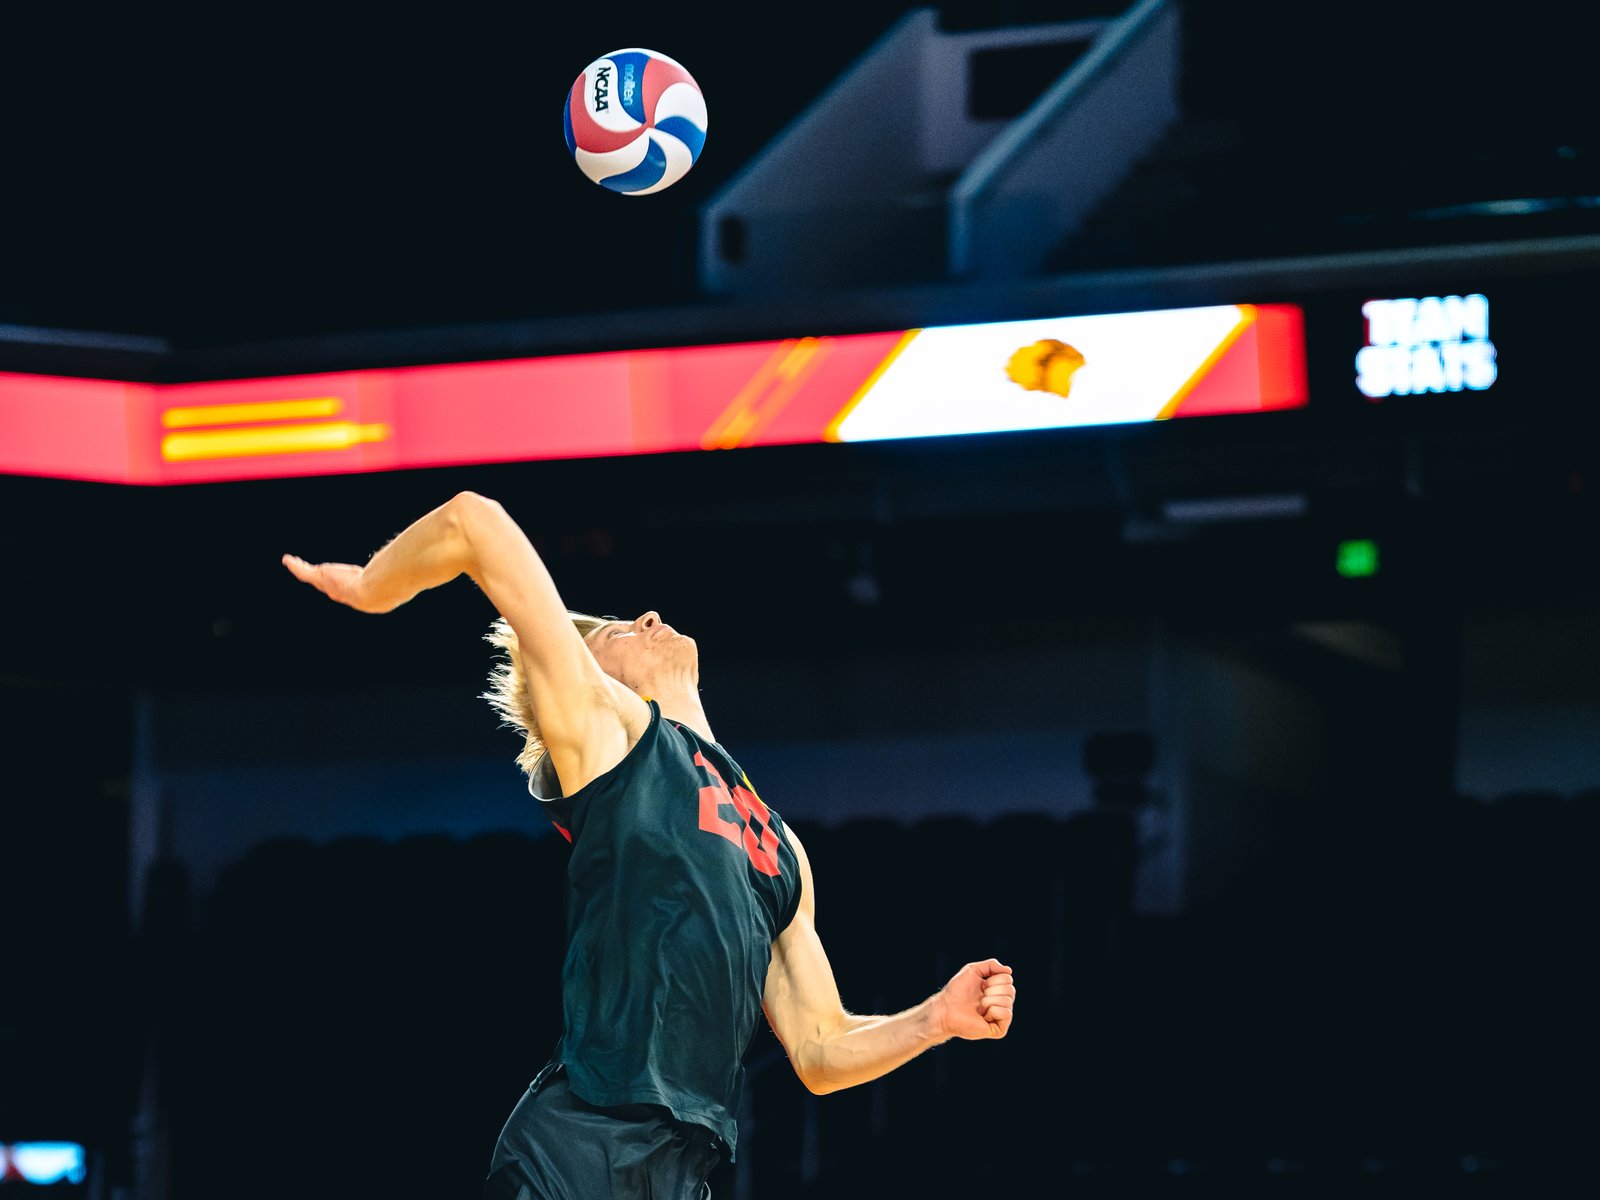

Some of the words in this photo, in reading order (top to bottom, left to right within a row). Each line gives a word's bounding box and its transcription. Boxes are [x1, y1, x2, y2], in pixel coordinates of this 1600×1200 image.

[594, 66, 611, 112] NCAA
[623, 63, 636, 106] molten
[693, 750, 782, 878] 20
